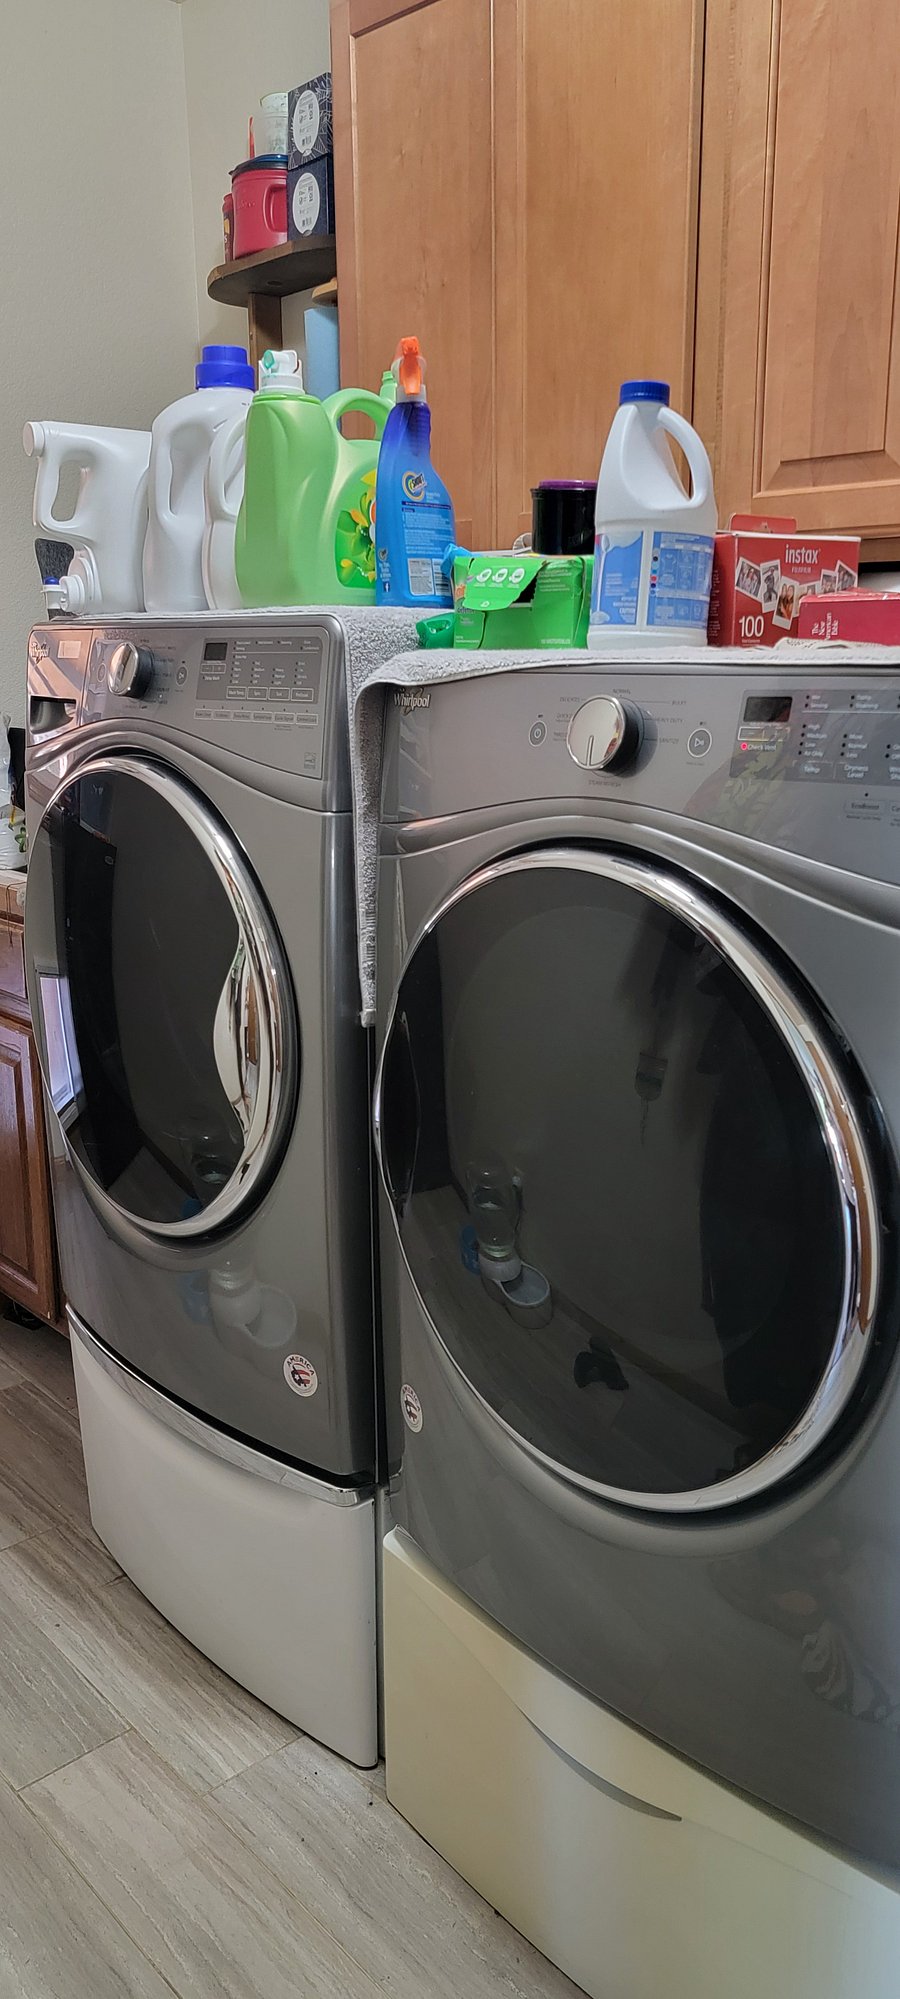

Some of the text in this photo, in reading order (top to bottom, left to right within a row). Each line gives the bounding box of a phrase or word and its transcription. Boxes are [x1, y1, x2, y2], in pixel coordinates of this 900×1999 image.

[785, 544, 818, 564] instax
[739, 615, 765, 638] 100
[393, 692, 431, 711] Whirlpool
[747, 743, 764, 751] Check
[287, 1356, 315, 1376] AMERICA
